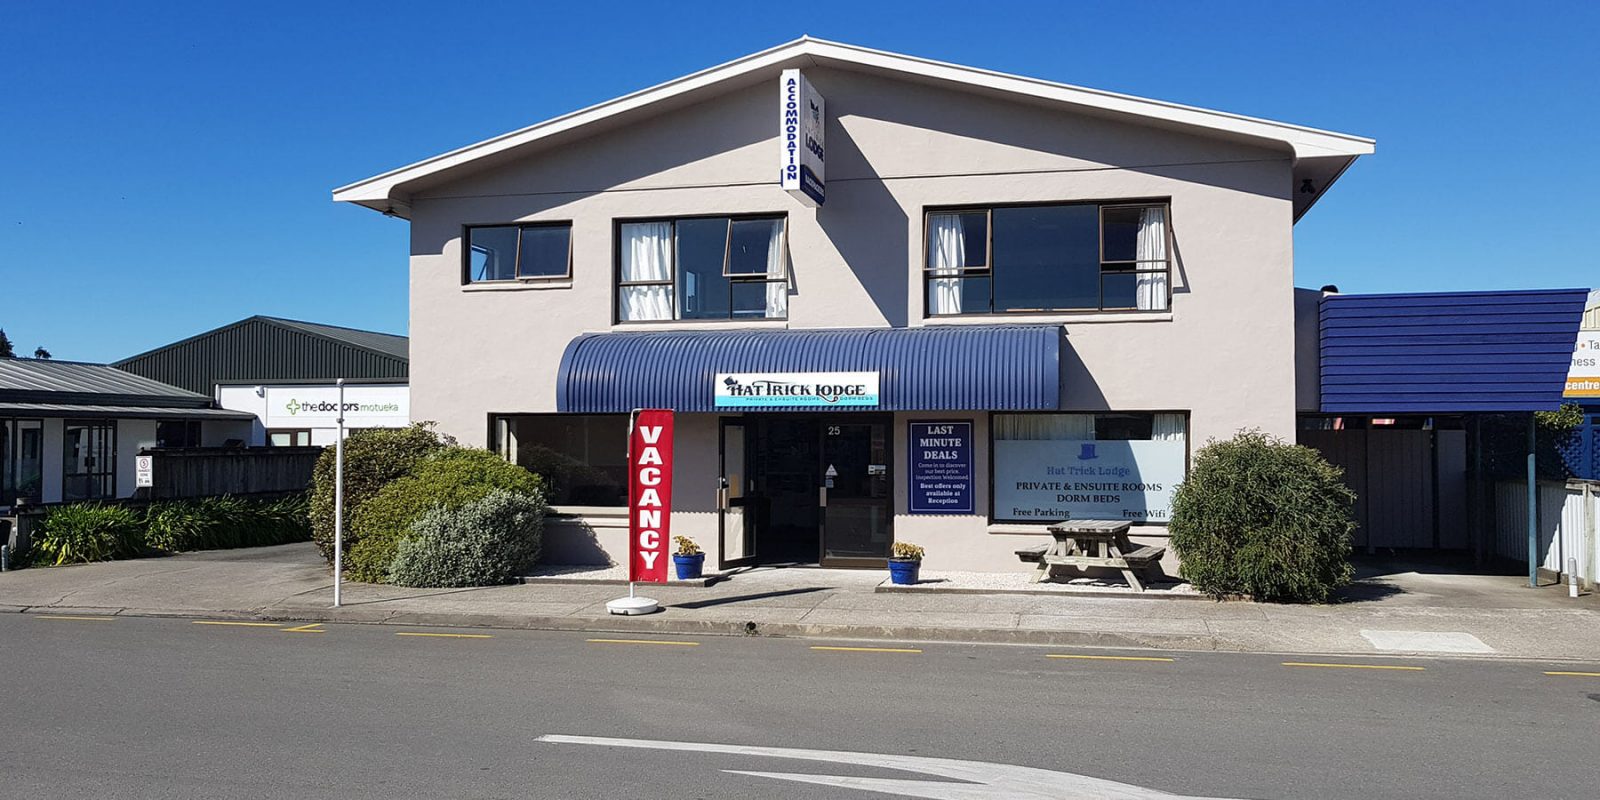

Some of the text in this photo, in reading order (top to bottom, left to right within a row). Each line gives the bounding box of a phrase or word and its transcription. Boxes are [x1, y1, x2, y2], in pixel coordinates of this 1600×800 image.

[786, 78, 798, 180] ACCOMMODATION
[727, 381, 866, 402] HAT TRICK LODGE
[361, 403, 399, 411] motueka
[828, 426, 841, 435] 25
[928, 426, 954, 434] LAST
[920, 439, 962, 447] MINUTE
[924, 451, 958, 459] DEALS
[1047, 466, 1130, 478] Hat Trick Lodge
[1016, 482, 1162, 491] PRIVATE & ENSUITE ROOMS
[638, 426, 663, 570] VACANCY
[1057, 494, 1120, 503] DORM BEDS
[1013, 508, 1070, 518] Free Parking
[1123, 509, 1166, 518] Free Wifi
